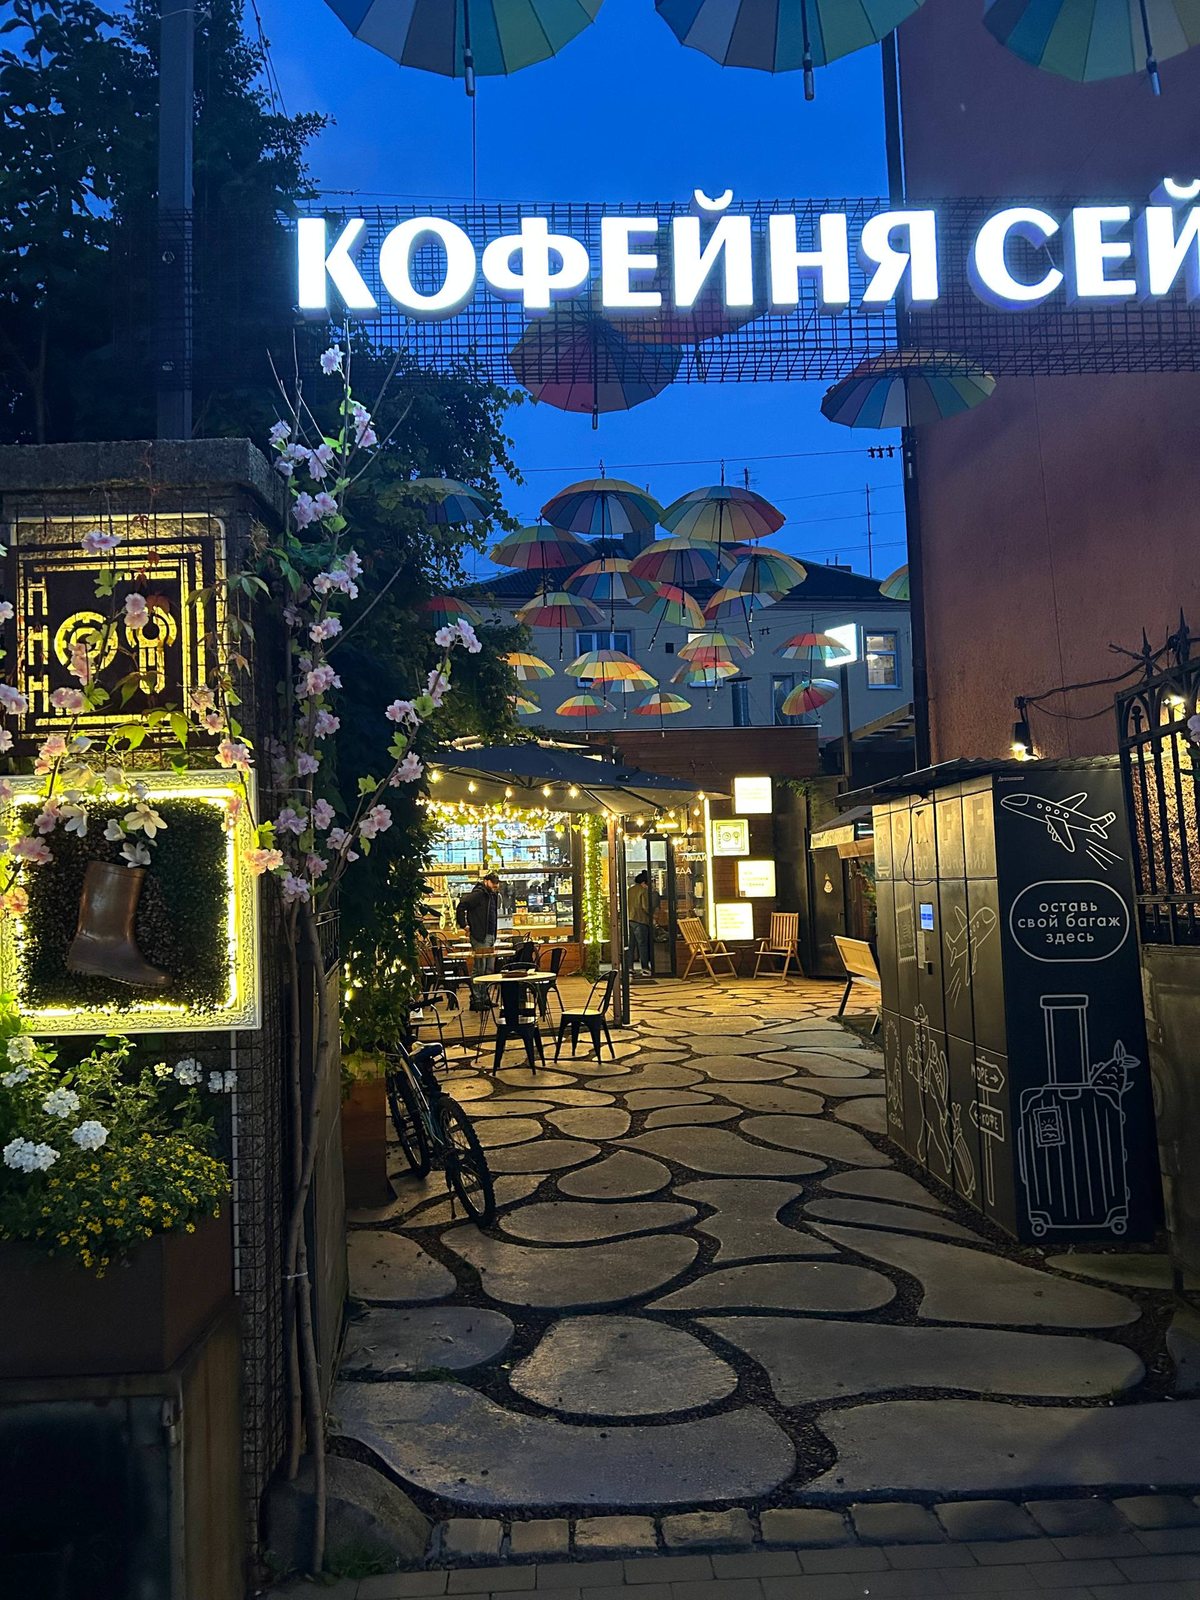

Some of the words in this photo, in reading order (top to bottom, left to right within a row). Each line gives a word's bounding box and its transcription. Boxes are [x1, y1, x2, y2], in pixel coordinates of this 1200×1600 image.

[296, 189, 940, 312] КОФЕЙНЯ
[1039, 902, 1098, 913] оставь
[1017, 914, 1059, 928] свой
[1066, 912, 1121, 927] багаж
[1046, 932, 1095, 945] здесь
